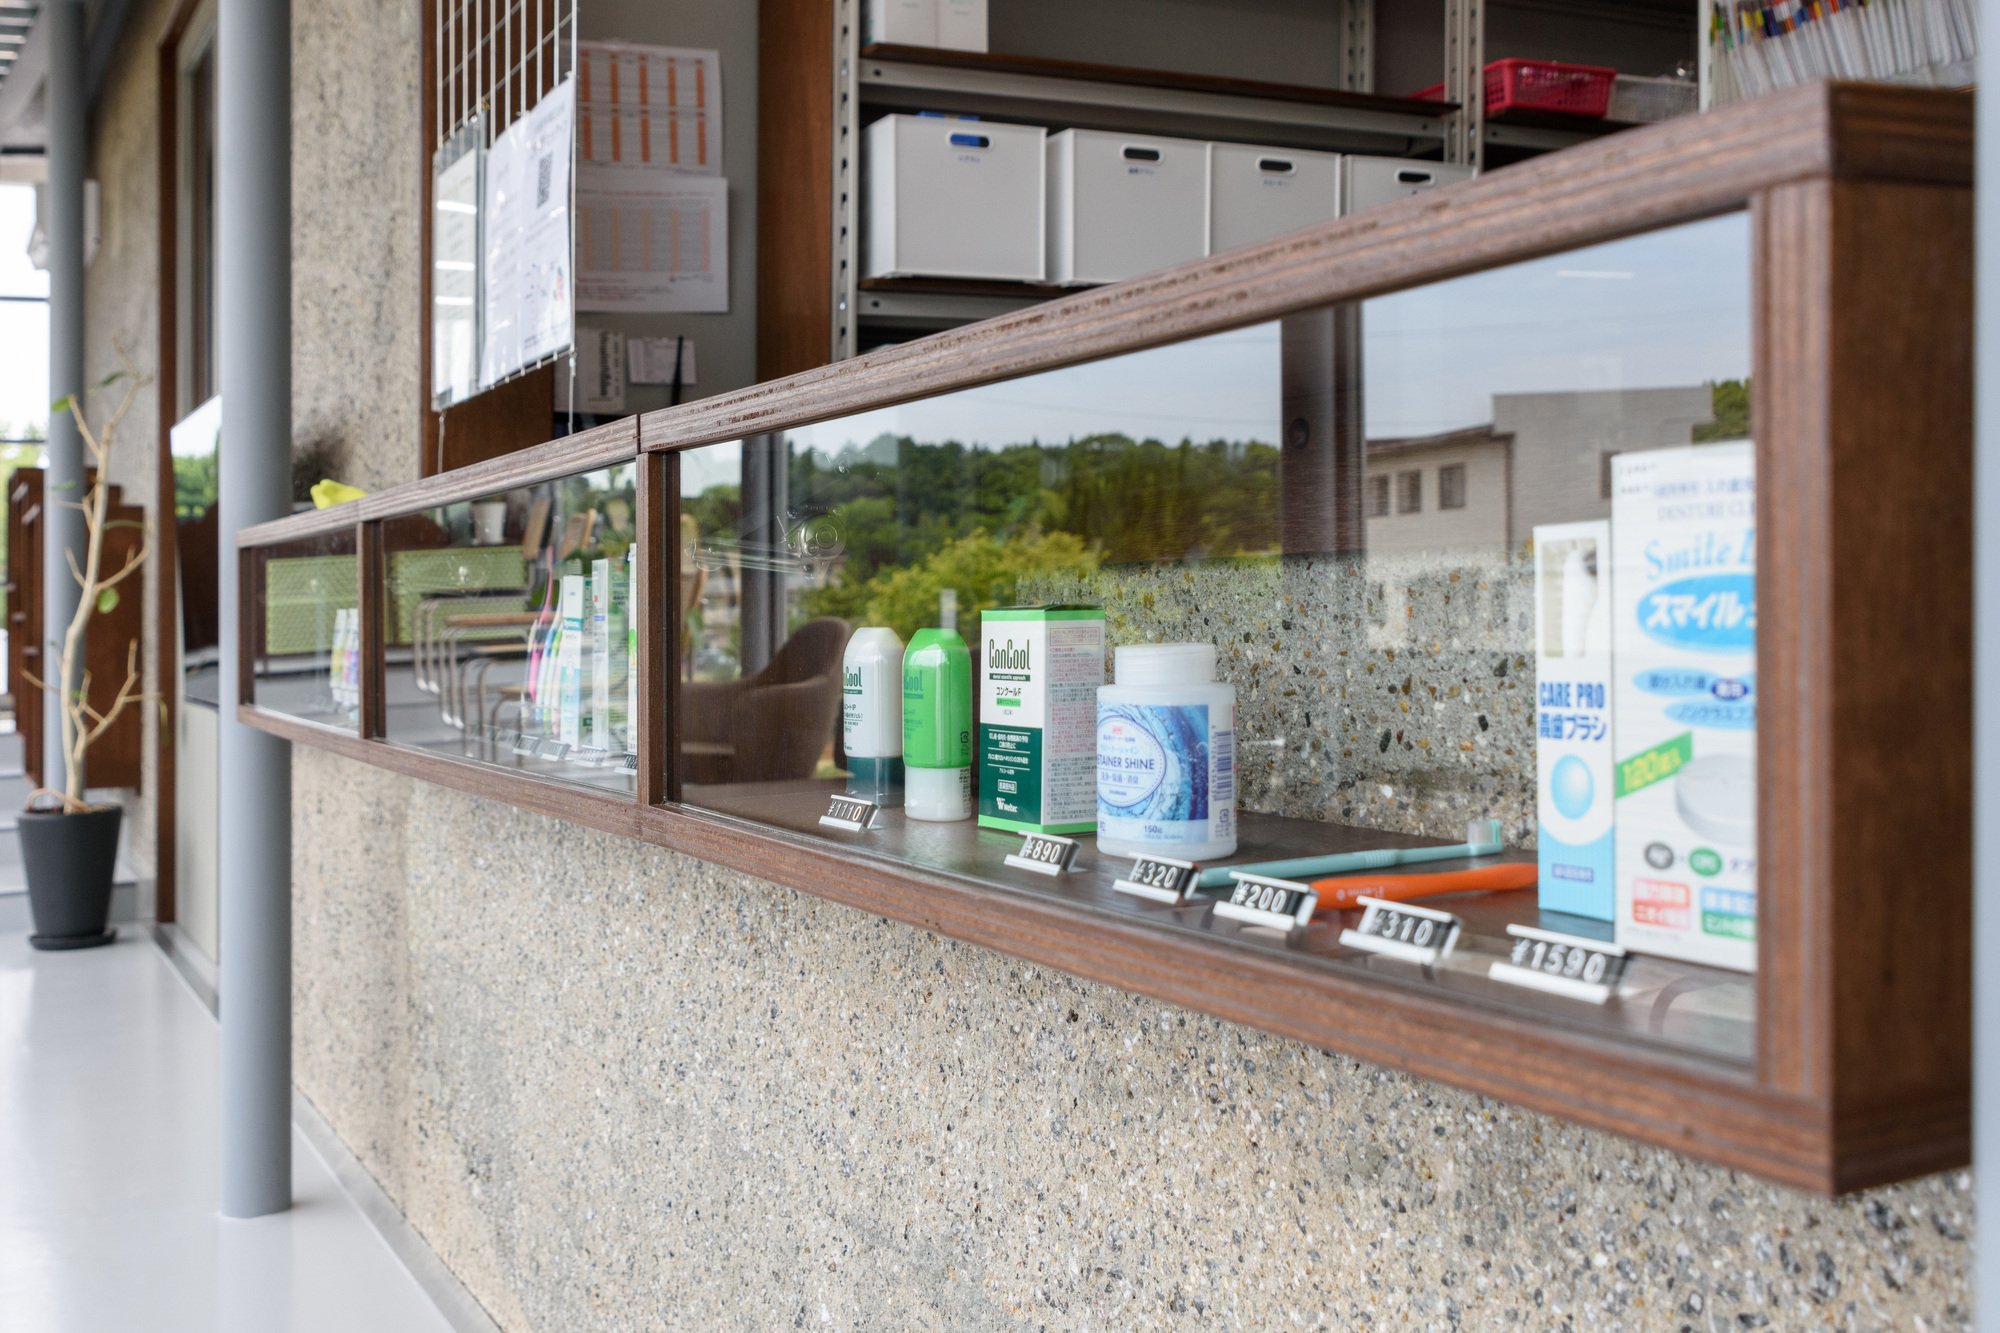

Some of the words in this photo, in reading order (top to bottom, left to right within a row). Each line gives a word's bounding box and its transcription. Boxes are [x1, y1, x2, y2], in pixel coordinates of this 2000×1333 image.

[1644, 531, 1732, 580] Smile
[989, 638, 1031, 671] ConCool
[1540, 682, 1571, 708] CARE
[1576, 682, 1605, 709] PRO
[1539, 712, 1607, 741] 義歯ブラシ
[1097, 754, 1122, 768] ETAINER
[1125, 758, 1155, 770] SHINE
[828, 801, 862, 821] ¥1110
[1024, 839, 1062, 864] ¥890
[1133, 862, 1178, 888] ¥320
[1233, 882, 1288, 914] ¥200
[1511, 937, 1607, 984] ¥1590
